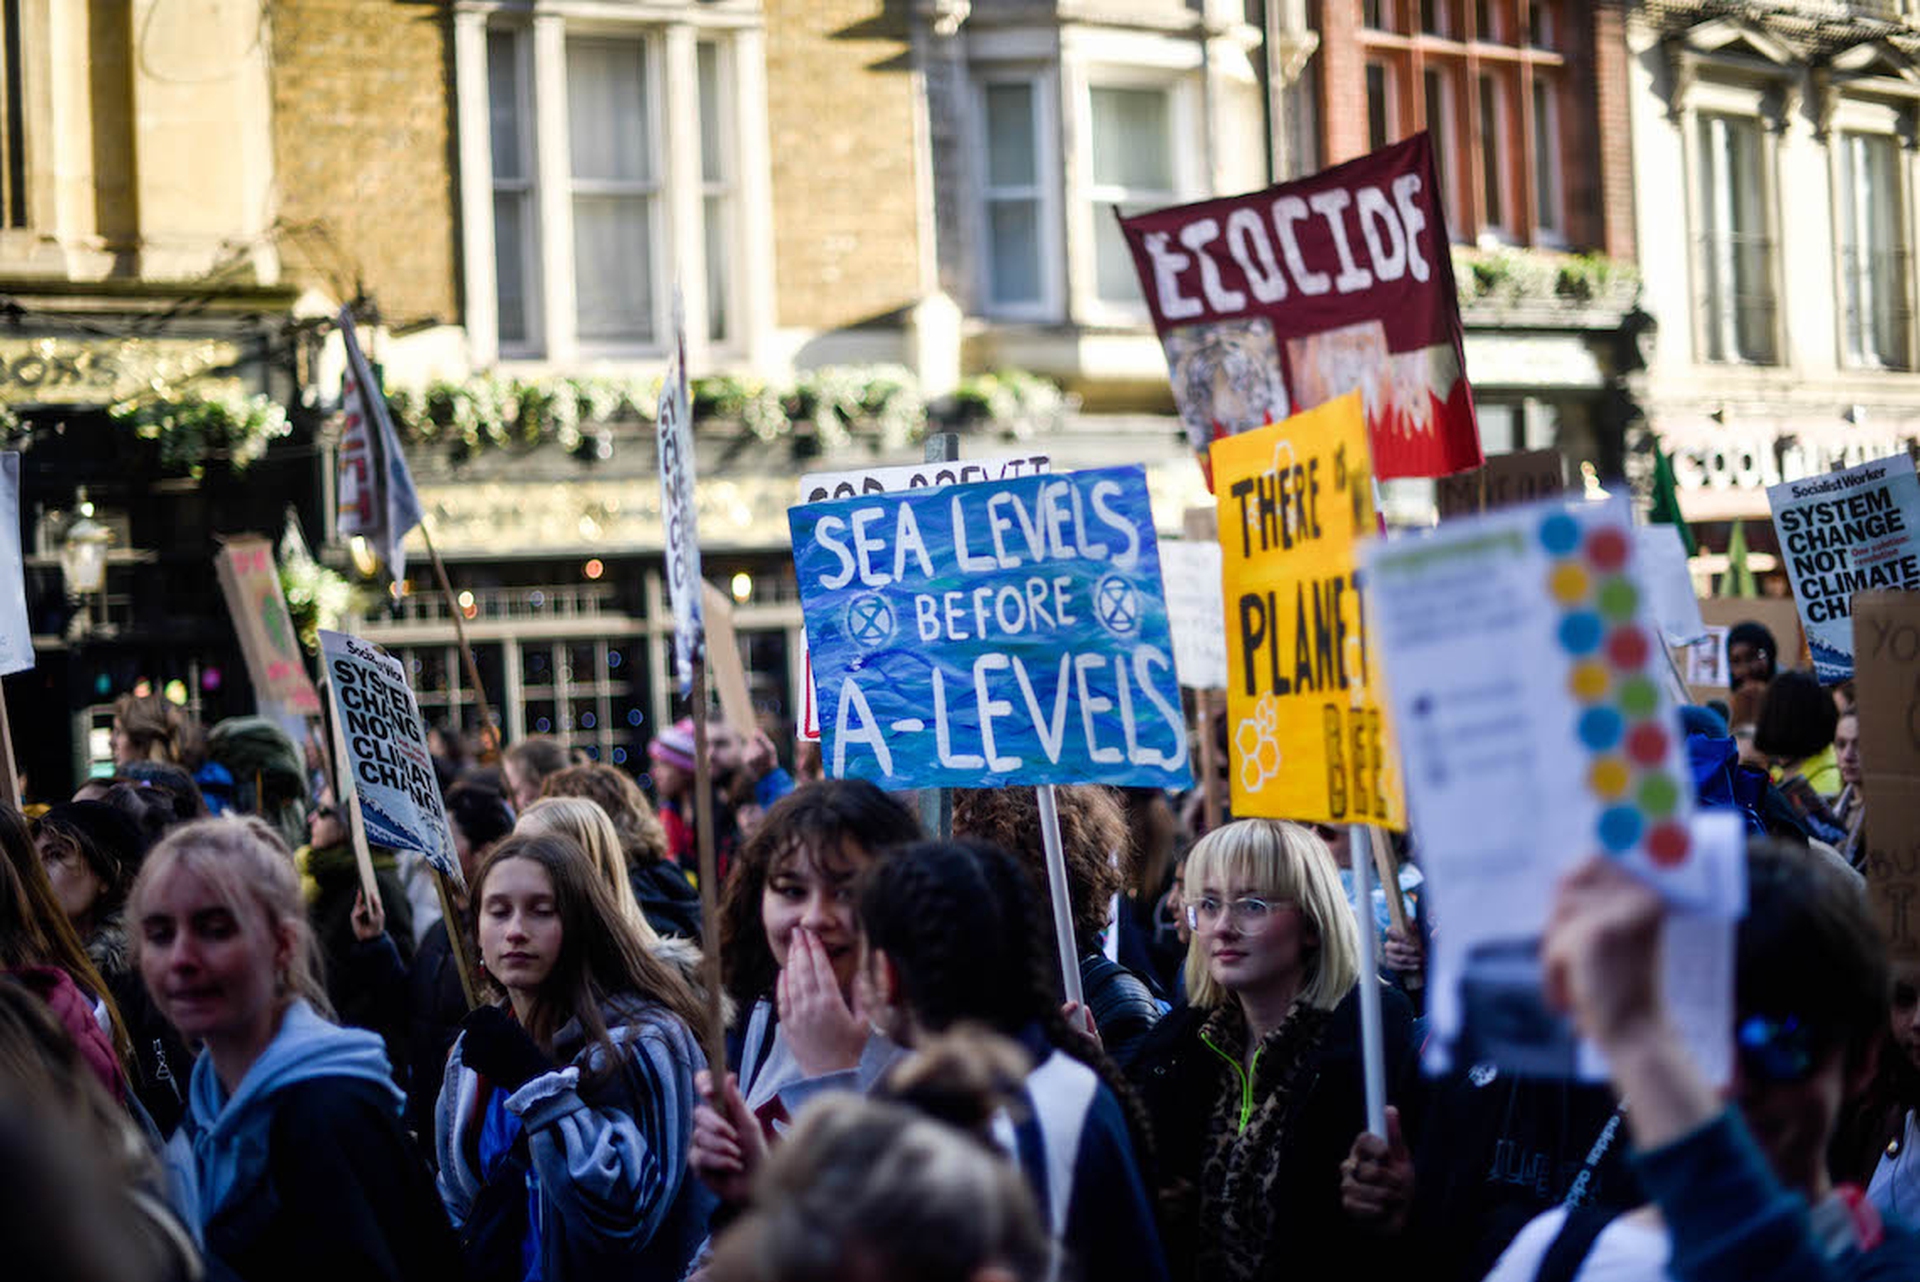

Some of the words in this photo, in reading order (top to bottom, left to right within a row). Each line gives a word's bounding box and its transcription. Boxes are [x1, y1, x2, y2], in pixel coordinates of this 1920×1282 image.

[1144, 173, 1431, 320] ECOCIDE
[1231, 458, 1321, 559] THERE
[1780, 486, 1893, 532] SYSTEM
[1791, 476, 1842, 498] Socialist
[1841, 466, 1887, 489] Worker
[815, 502, 934, 590] SEA
[952, 480, 1140, 571] LEVELS
[1787, 508, 1906, 555] CHANGE
[1793, 549, 1849, 579] NOT
[915, 576, 1076, 641] BEFORE
[1800, 554, 1920, 601] CLIMATE
[1239, 568, 1369, 697] PLANET
[832, 643, 1188, 779] A-LEVELS
